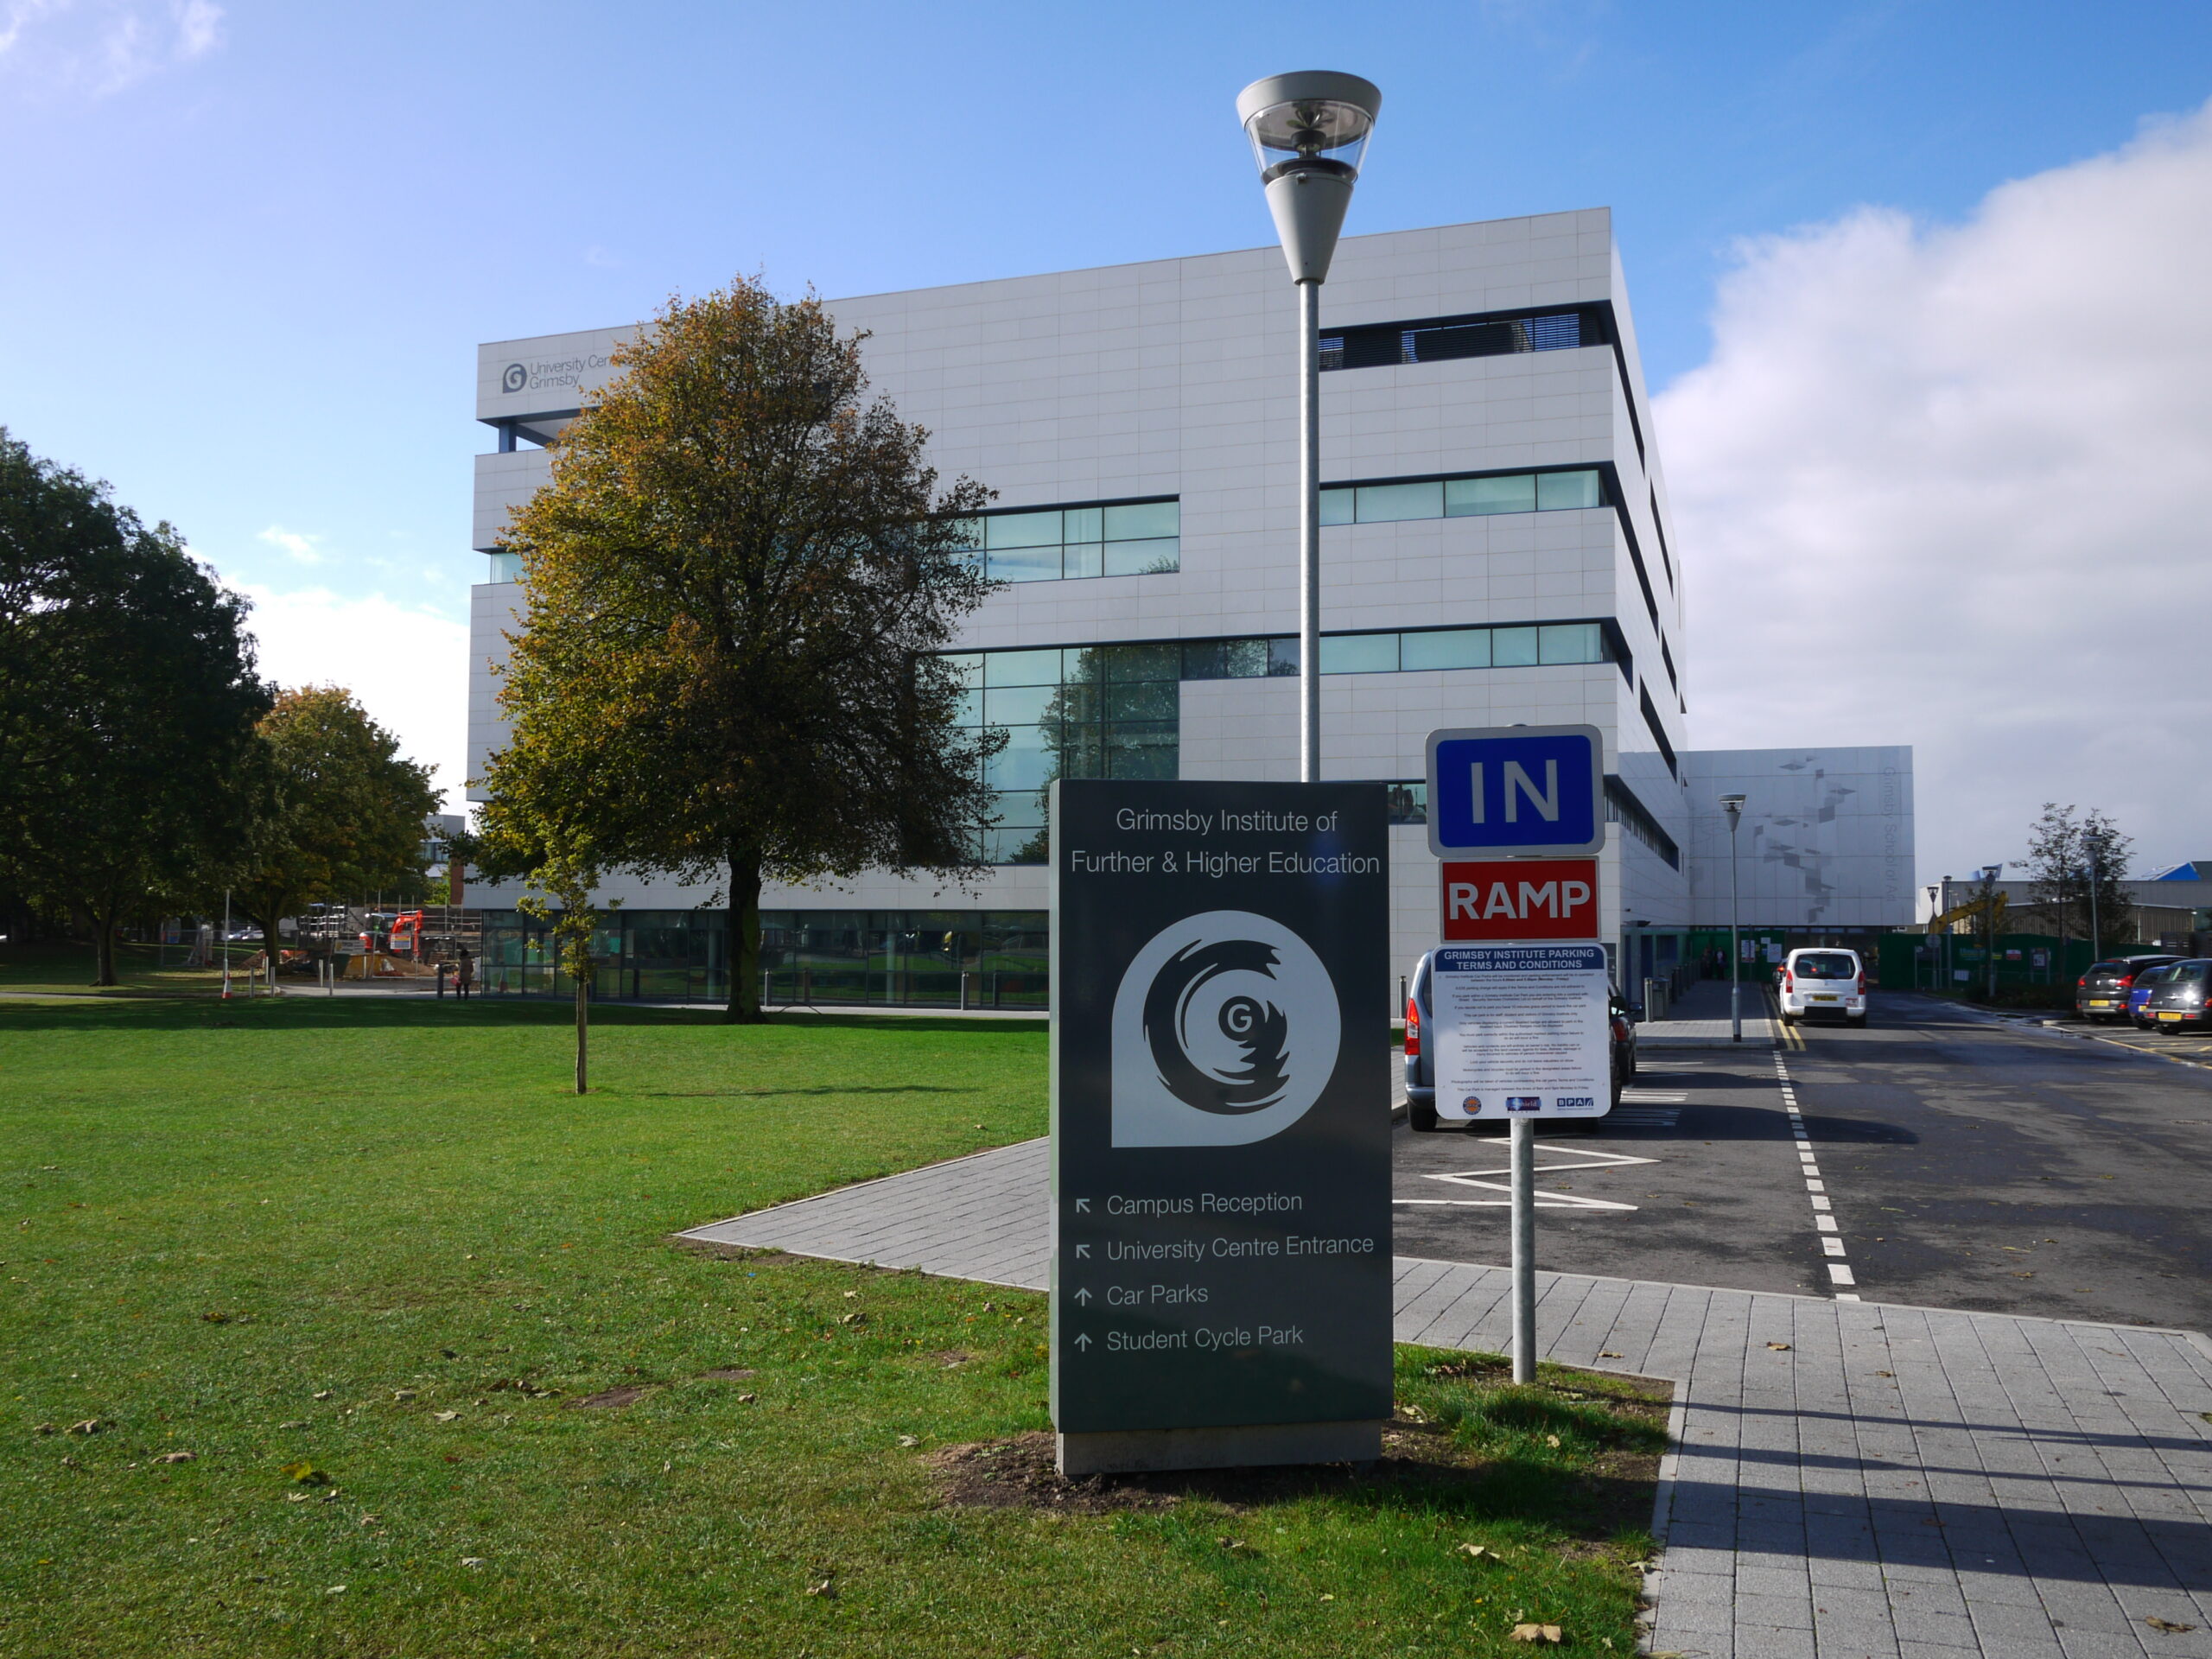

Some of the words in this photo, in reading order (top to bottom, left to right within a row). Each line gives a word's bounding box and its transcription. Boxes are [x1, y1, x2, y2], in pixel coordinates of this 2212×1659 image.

[531, 357, 587, 375] University
[530, 373, 580, 390] Grimsby
[1471, 760, 1560, 824] IN
[1116, 808, 1213, 836] Grimsby
[1222, 810, 1308, 832] Institute
[1316, 811, 1338, 832] of
[1072, 850, 1154, 873] Further
[1161, 851, 1178, 873] &
[1186, 851, 1261, 878] Higher
[1269, 852, 1380, 874] Education
[1449, 880, 1591, 919] RAMP
[1444, 950, 1492, 960] GRIMSBY
[1493, 950, 1547, 959] INSTITUTE
[1548, 949, 1594, 958] PARKING
[1456, 961, 1492, 969] TERMS
[1494, 960, 1516, 969] AND
[1520, 960, 1582, 969] CONDITIONS
[1227, 1003, 1253, 1033] G
[1107, 1195, 1193, 1218] Campus
[1202, 1192, 1302, 1216] Reception
[1107, 1239, 1205, 1262] University
[1212, 1238, 1279, 1257] Centre
[1287, 1236, 1374, 1255] Entrance
[1107, 1286, 1144, 1306] Car
[1152, 1284, 1209, 1304] Parks
[1107, 1330, 1188, 1351] Student
[1195, 1327, 1251, 1351] Cycle
[1259, 1325, 1303, 1345] Park
